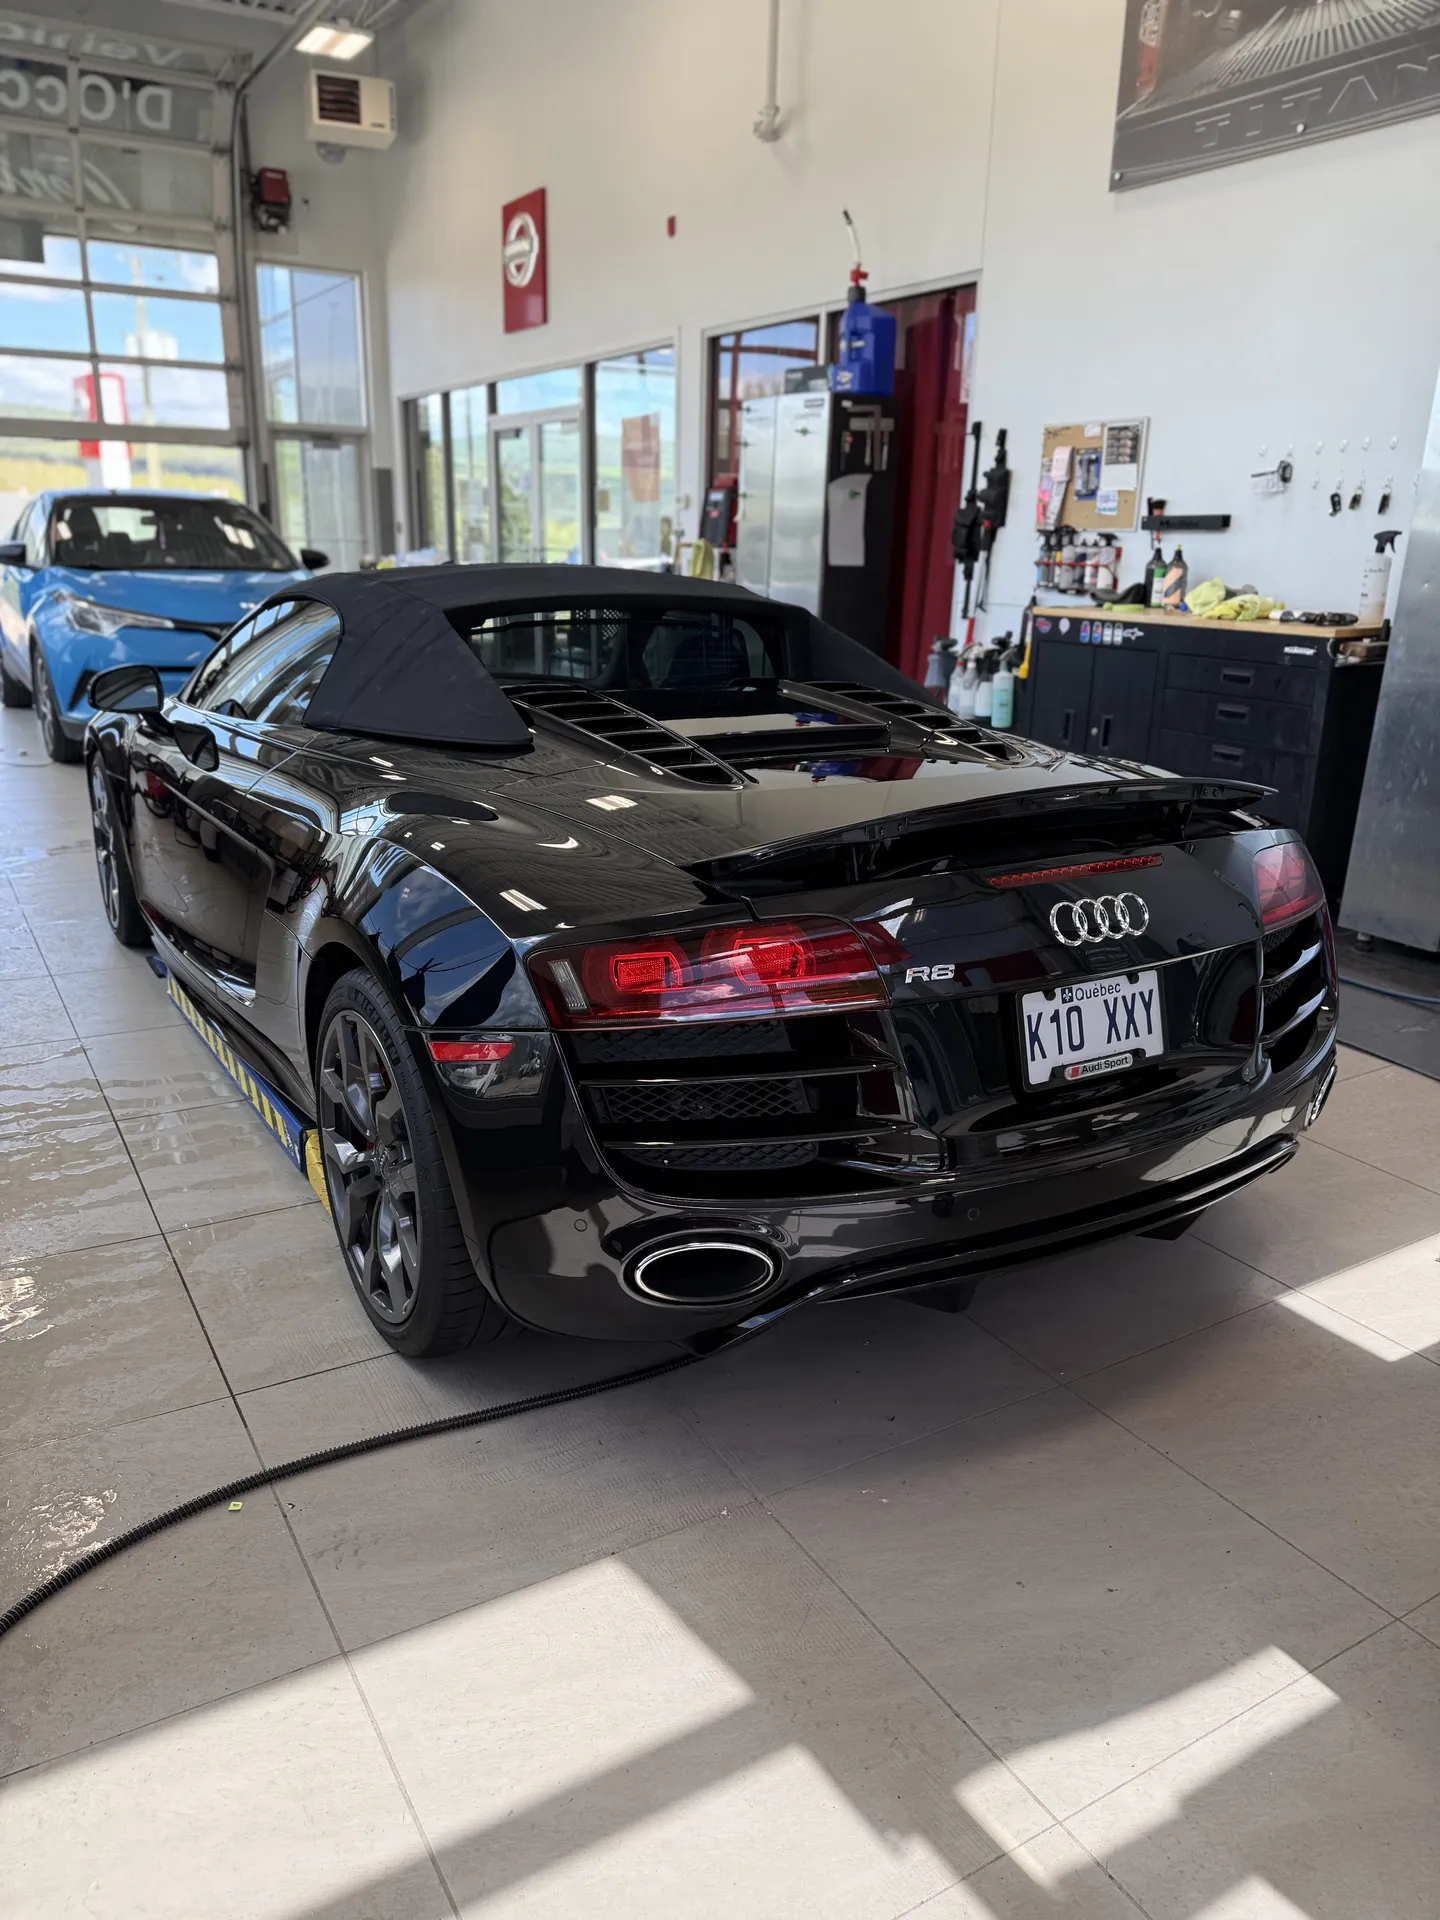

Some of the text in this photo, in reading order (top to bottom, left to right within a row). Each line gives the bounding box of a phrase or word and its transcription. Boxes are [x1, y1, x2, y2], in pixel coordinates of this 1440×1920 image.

[905, 964, 955, 984] R8
[1075, 983, 1121, 1001] Québec
[356, 989, 400, 1059] MICHELIN
[1026, 989, 1154, 1062] K10 XXY
[1081, 1057, 1129, 1074] Audi Sport
[400, 1071, 413, 1101] PILOT
